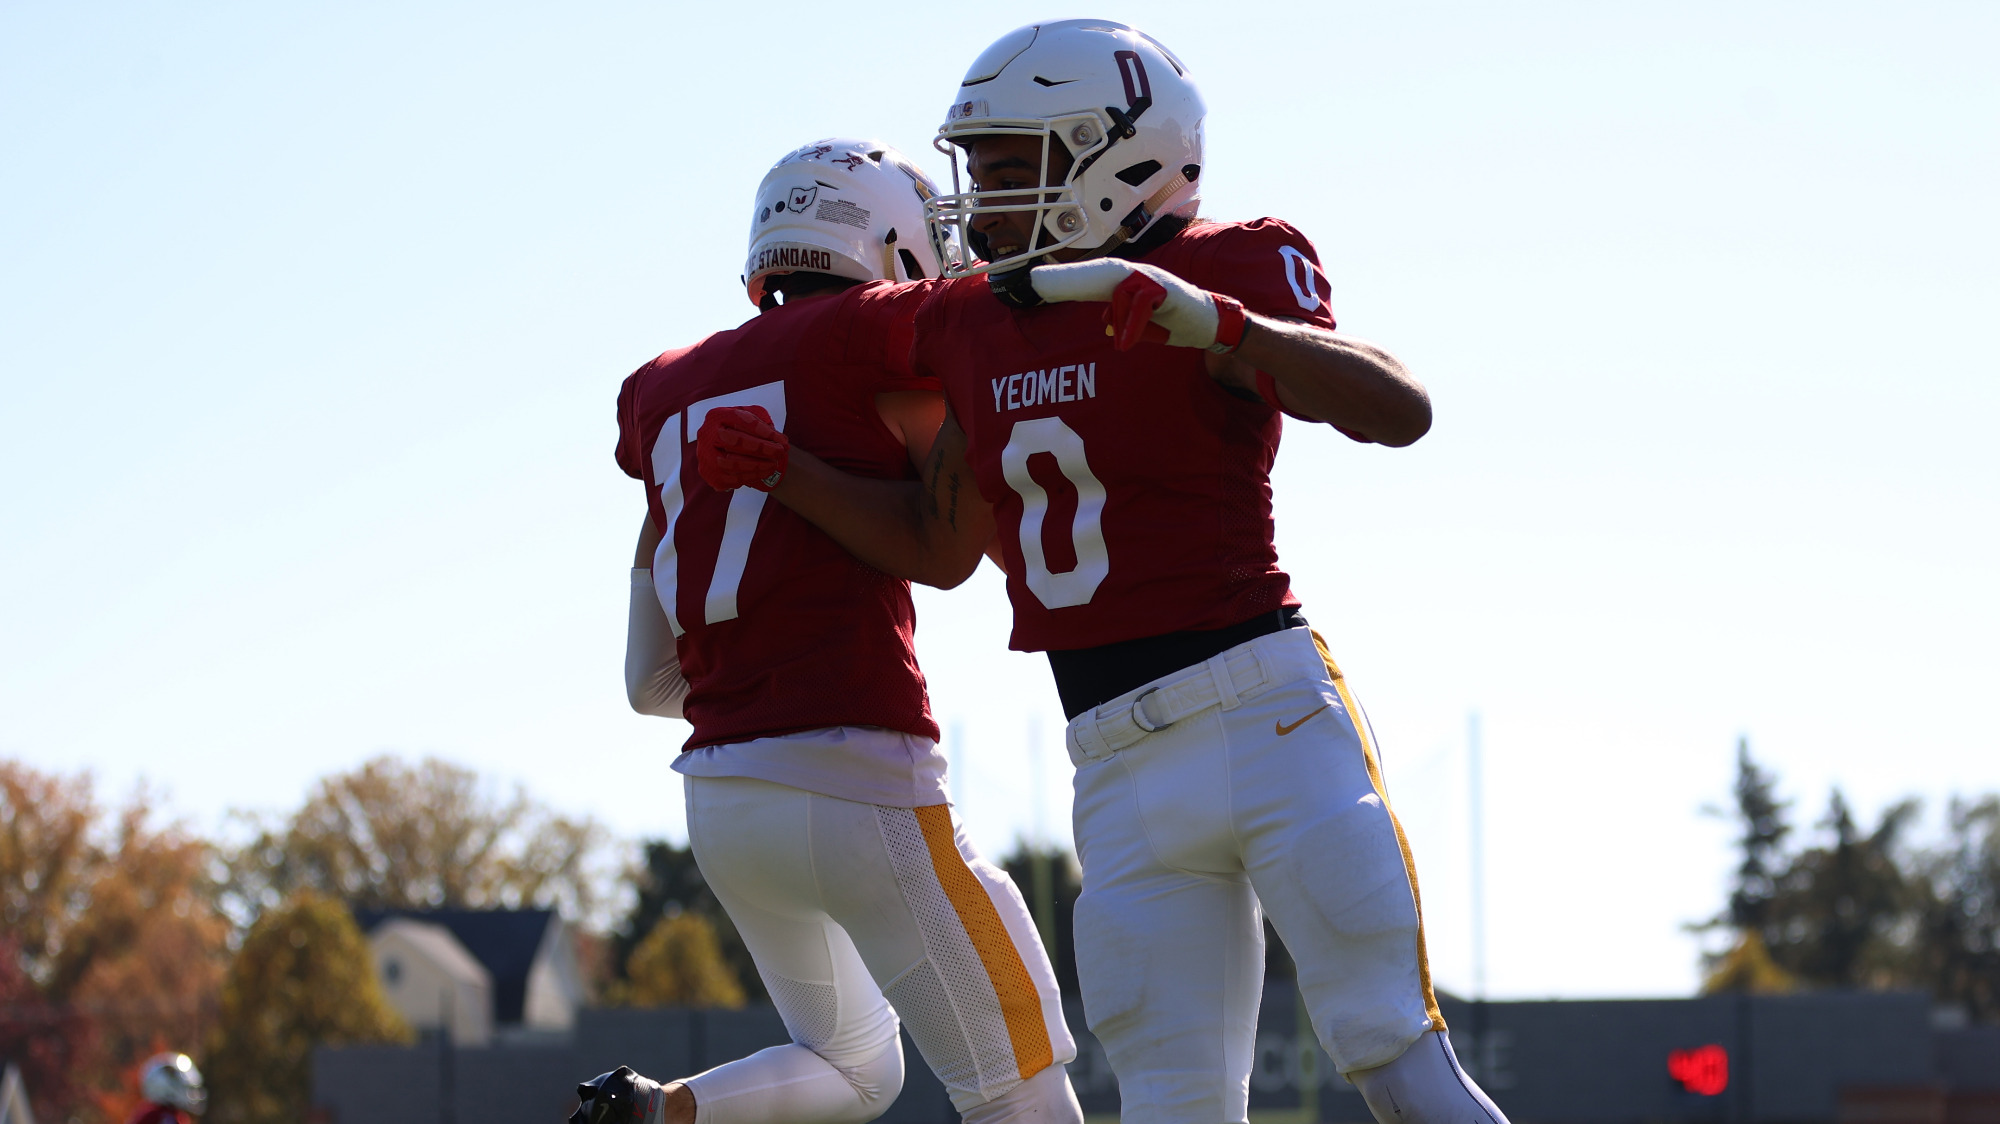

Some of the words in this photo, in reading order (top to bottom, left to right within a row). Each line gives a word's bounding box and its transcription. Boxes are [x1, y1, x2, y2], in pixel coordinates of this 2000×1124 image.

[758, 247, 831, 270] STANDARD
[1277, 245, 1320, 312] 0
[991, 362, 1096, 413] YEOMEN
[651, 380, 787, 639] 17
[1001, 416, 1110, 610] 0
